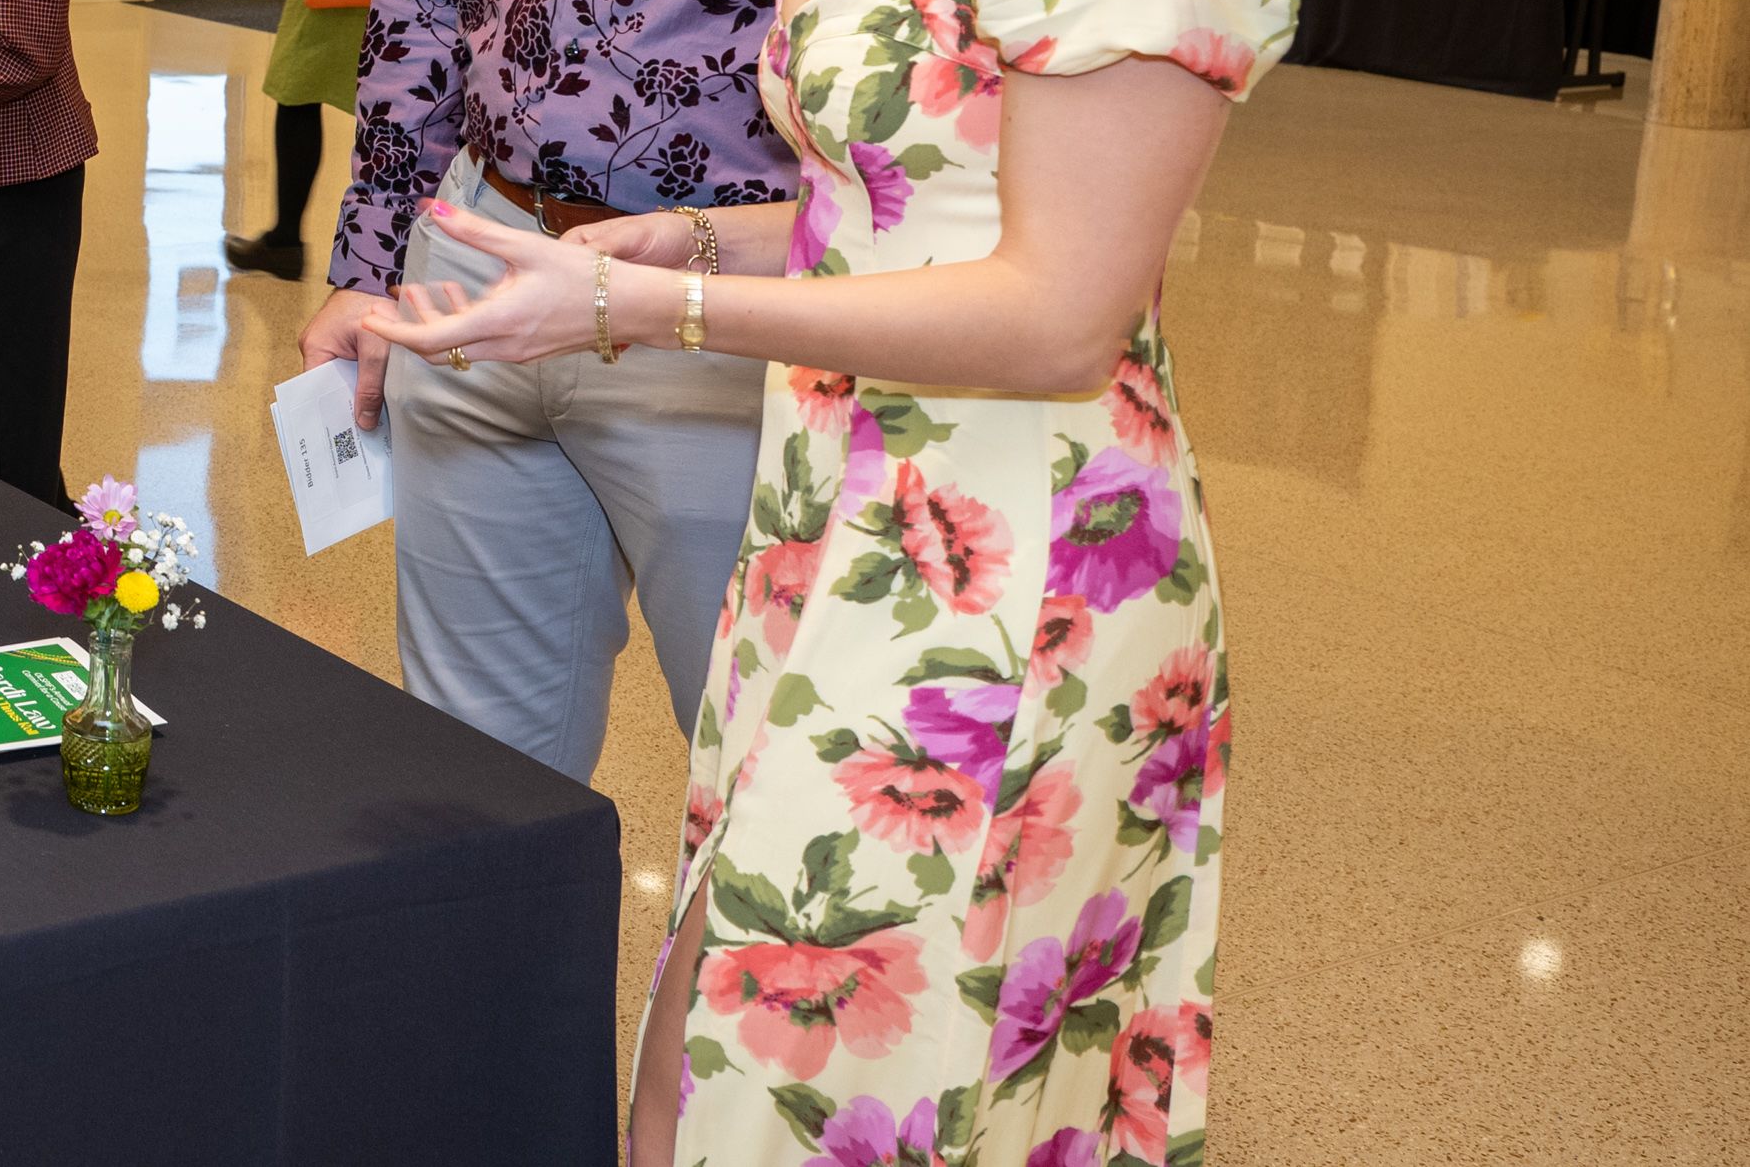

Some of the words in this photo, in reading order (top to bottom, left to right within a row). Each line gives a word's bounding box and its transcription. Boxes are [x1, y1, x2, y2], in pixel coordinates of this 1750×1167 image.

[299, 438, 308, 456] 135
[303, 458, 313, 488] Bidder
[14, 700, 56, 729] Law
[18, 721, 39, 735] Roll
